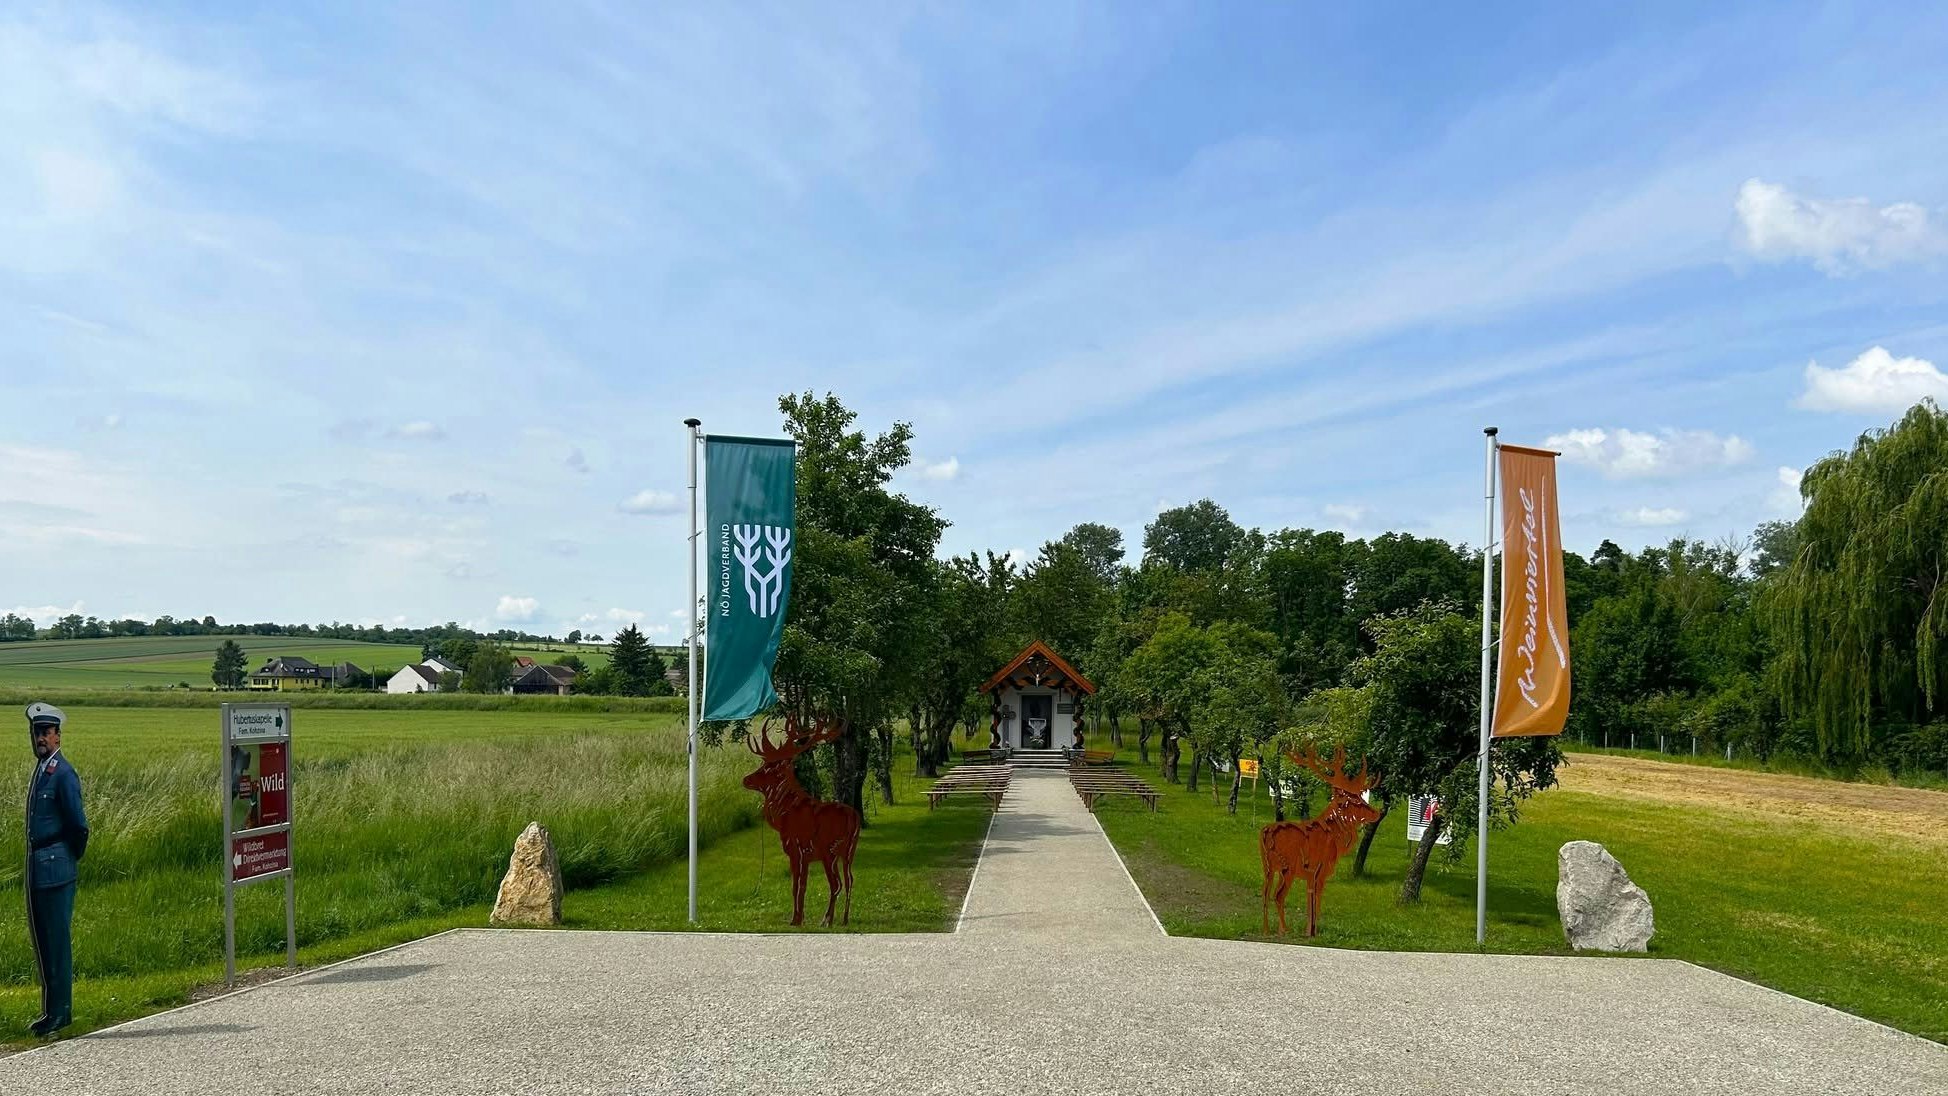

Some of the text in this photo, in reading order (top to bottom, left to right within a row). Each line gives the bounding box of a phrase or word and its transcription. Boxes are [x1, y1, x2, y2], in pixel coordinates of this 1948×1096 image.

[720, 523, 730, 616] NÖ JAGDVERBAND
[1517, 487, 1538, 708] Weinviertel
[233, 713, 272, 726] Hubertuskapelle
[260, 772, 284, 792] Wild
[243, 848, 287, 864] Direktvermarktung
